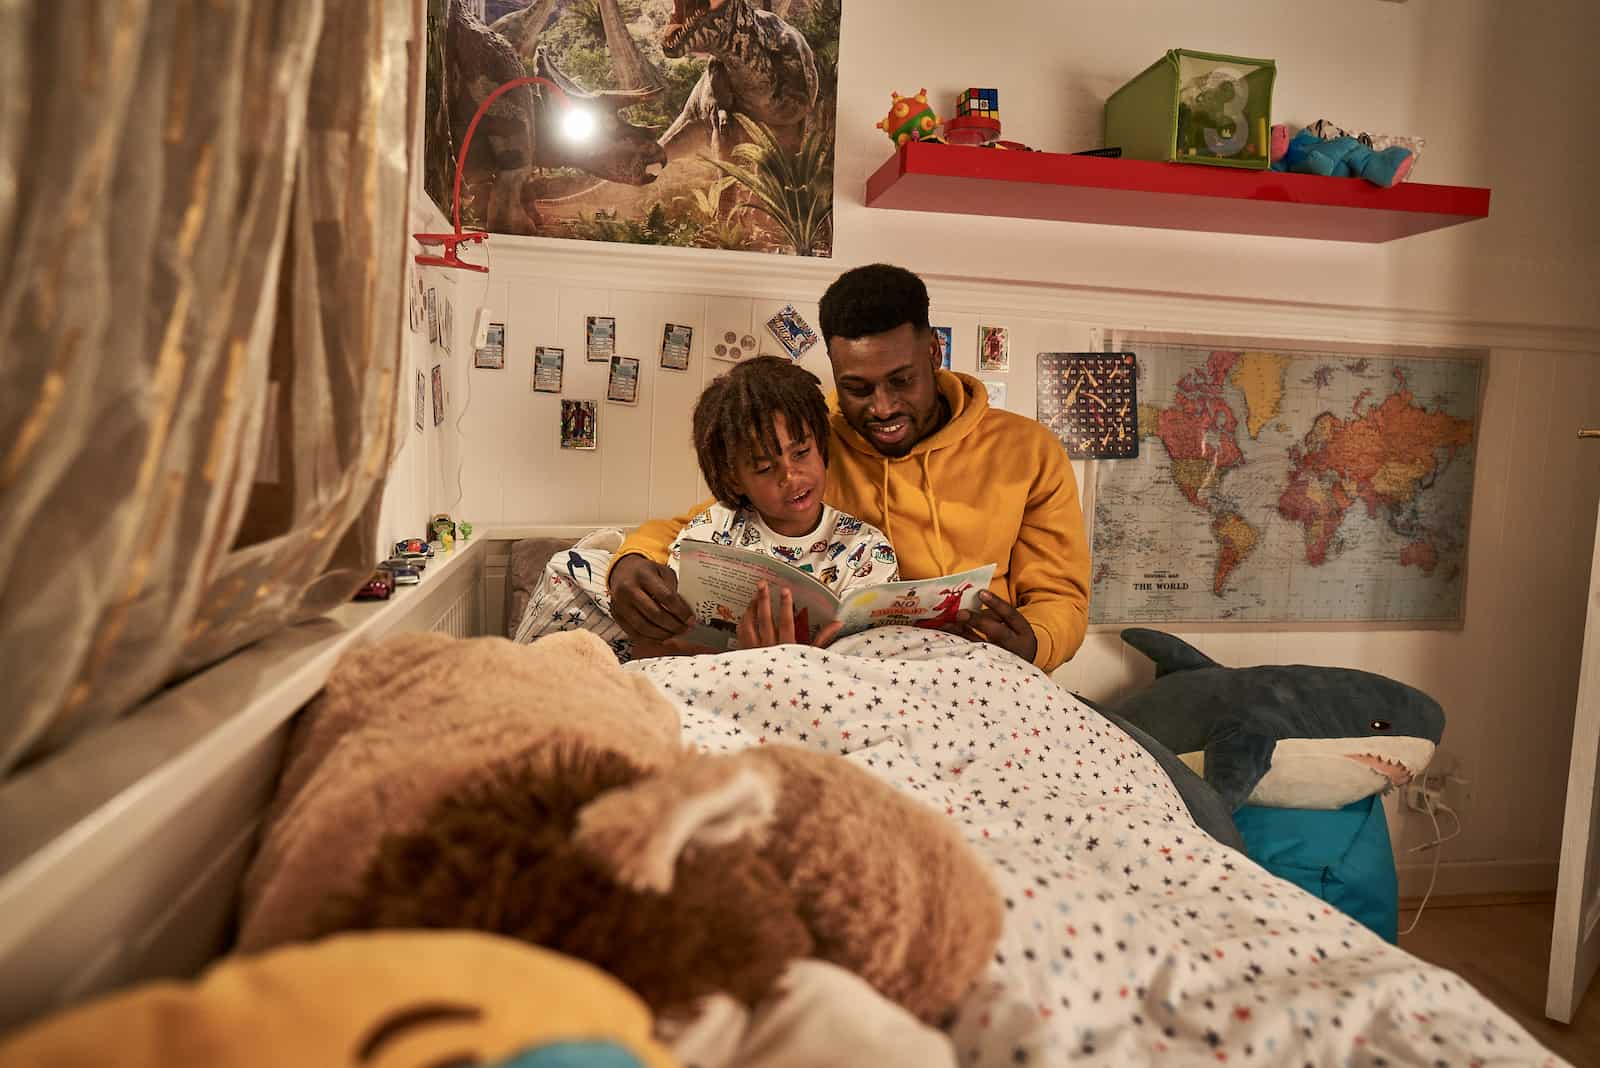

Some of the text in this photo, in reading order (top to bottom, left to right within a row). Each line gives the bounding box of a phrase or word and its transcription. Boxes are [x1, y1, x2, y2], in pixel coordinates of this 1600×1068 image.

[1203, 67, 1249, 156] 3
[1133, 582, 1190, 591] THE WORLD
[893, 599, 916, 609] NO
